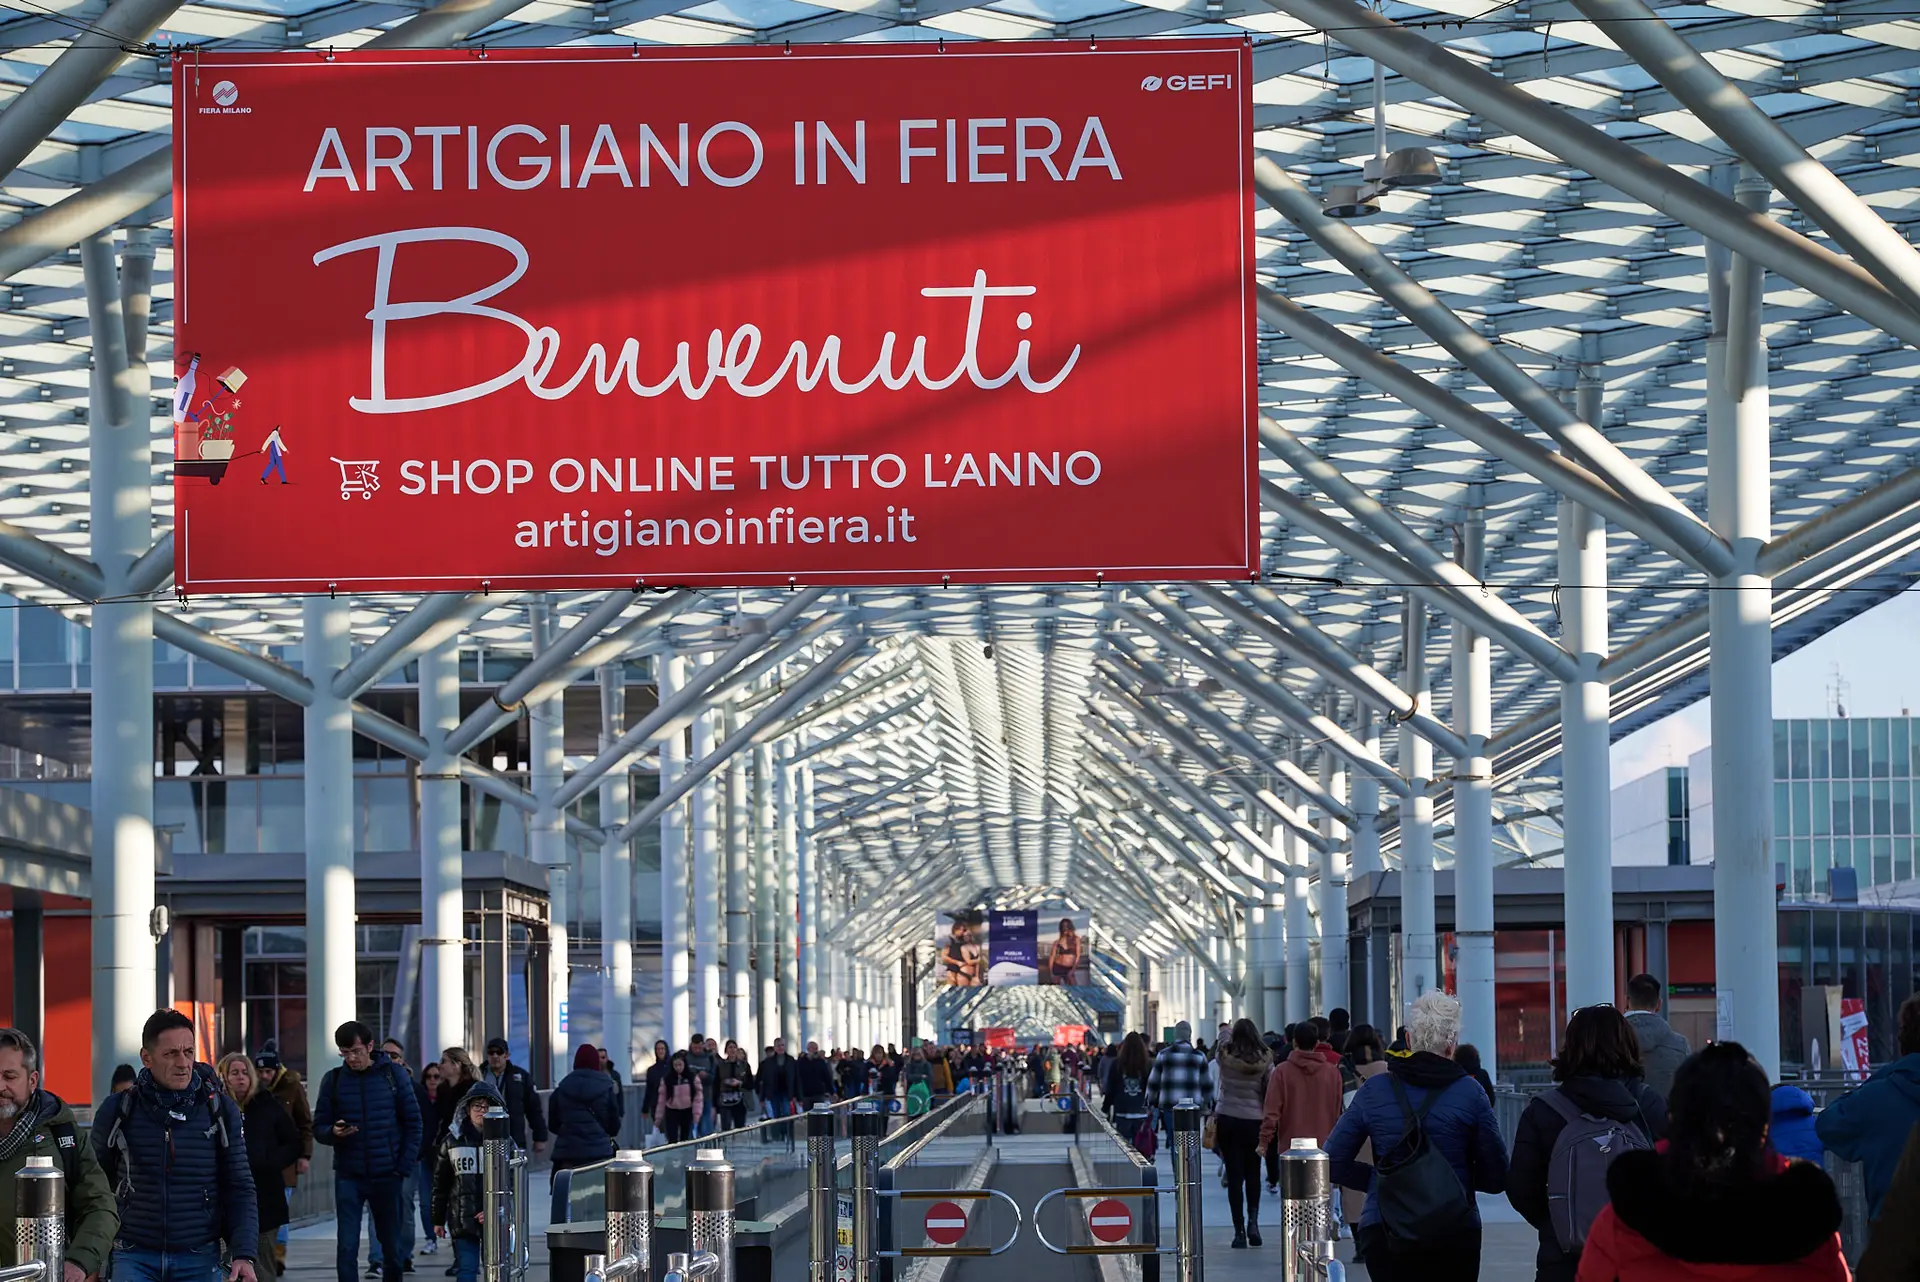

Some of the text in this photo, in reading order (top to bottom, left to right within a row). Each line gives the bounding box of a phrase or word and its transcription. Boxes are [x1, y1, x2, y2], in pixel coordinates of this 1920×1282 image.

[1166, 74, 1232, 91] GEFI
[303, 116, 1123, 193] ARTIGIANO IN FIERA
[313, 226, 1083, 414] Benvenuti
[399, 458, 534, 495] SHOP
[549, 456, 735, 494] ONLINE
[750, 453, 907, 490] TUTTO
[514, 505, 917, 557] artigianoinfiera.it
[453, 1157, 474, 1171] EEP
